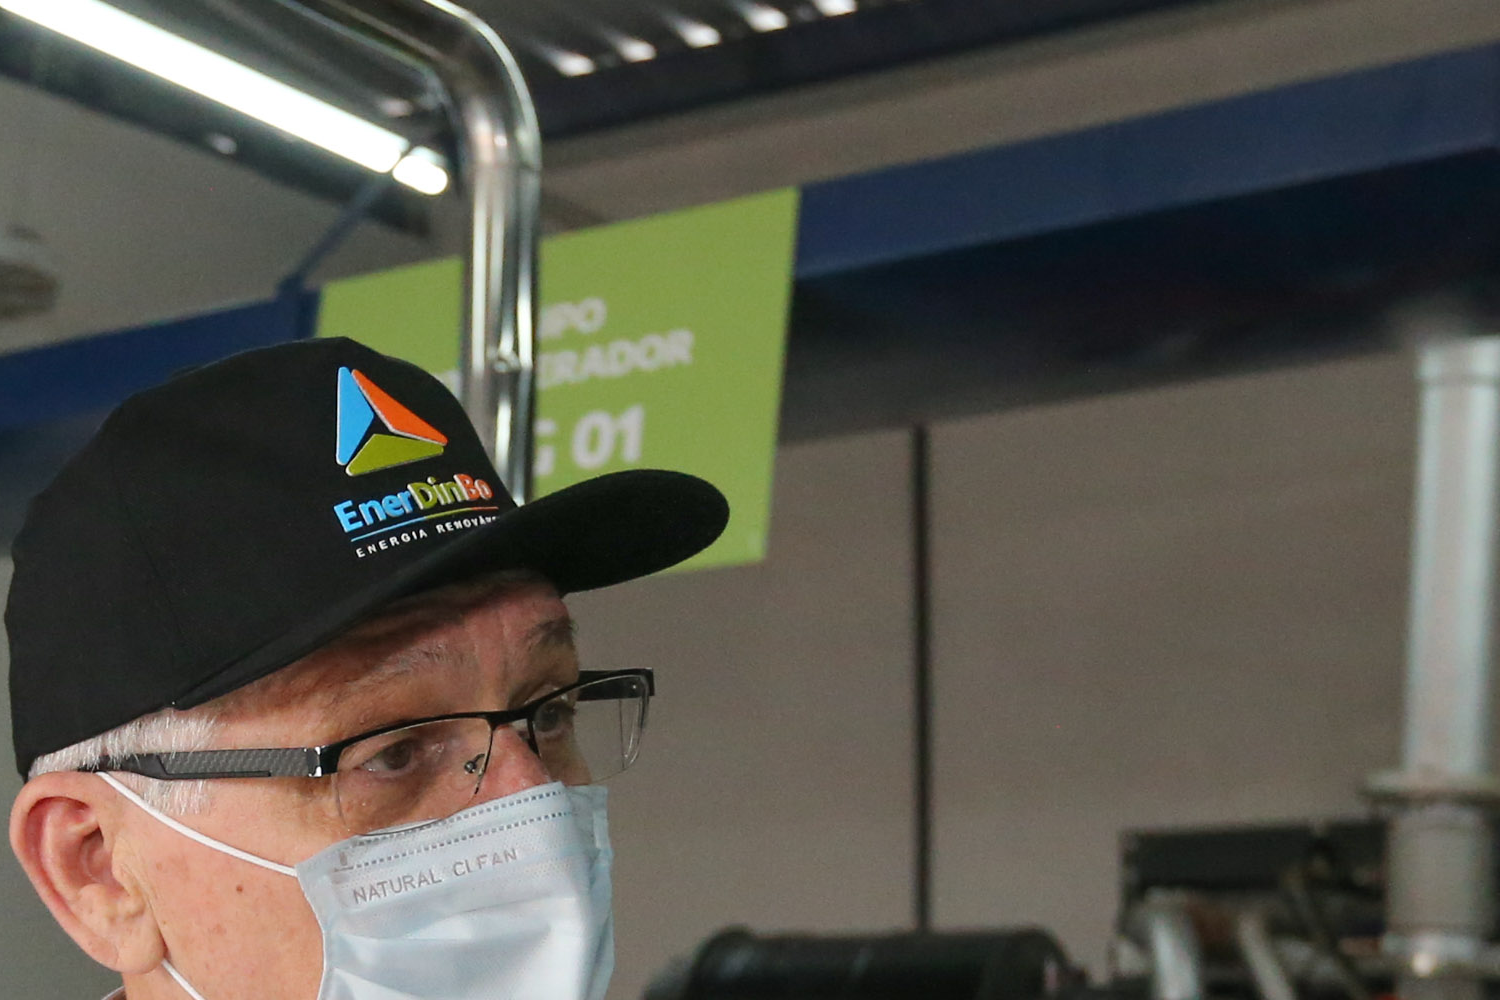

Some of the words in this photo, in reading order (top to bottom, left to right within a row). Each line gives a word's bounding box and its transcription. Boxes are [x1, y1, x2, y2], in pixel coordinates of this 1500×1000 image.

[571, 402, 645, 469] 01
[333, 473, 494, 533] EnerDinBo
[355, 528, 428, 558] ENERGIA
[352, 868, 443, 904] NATURAL
